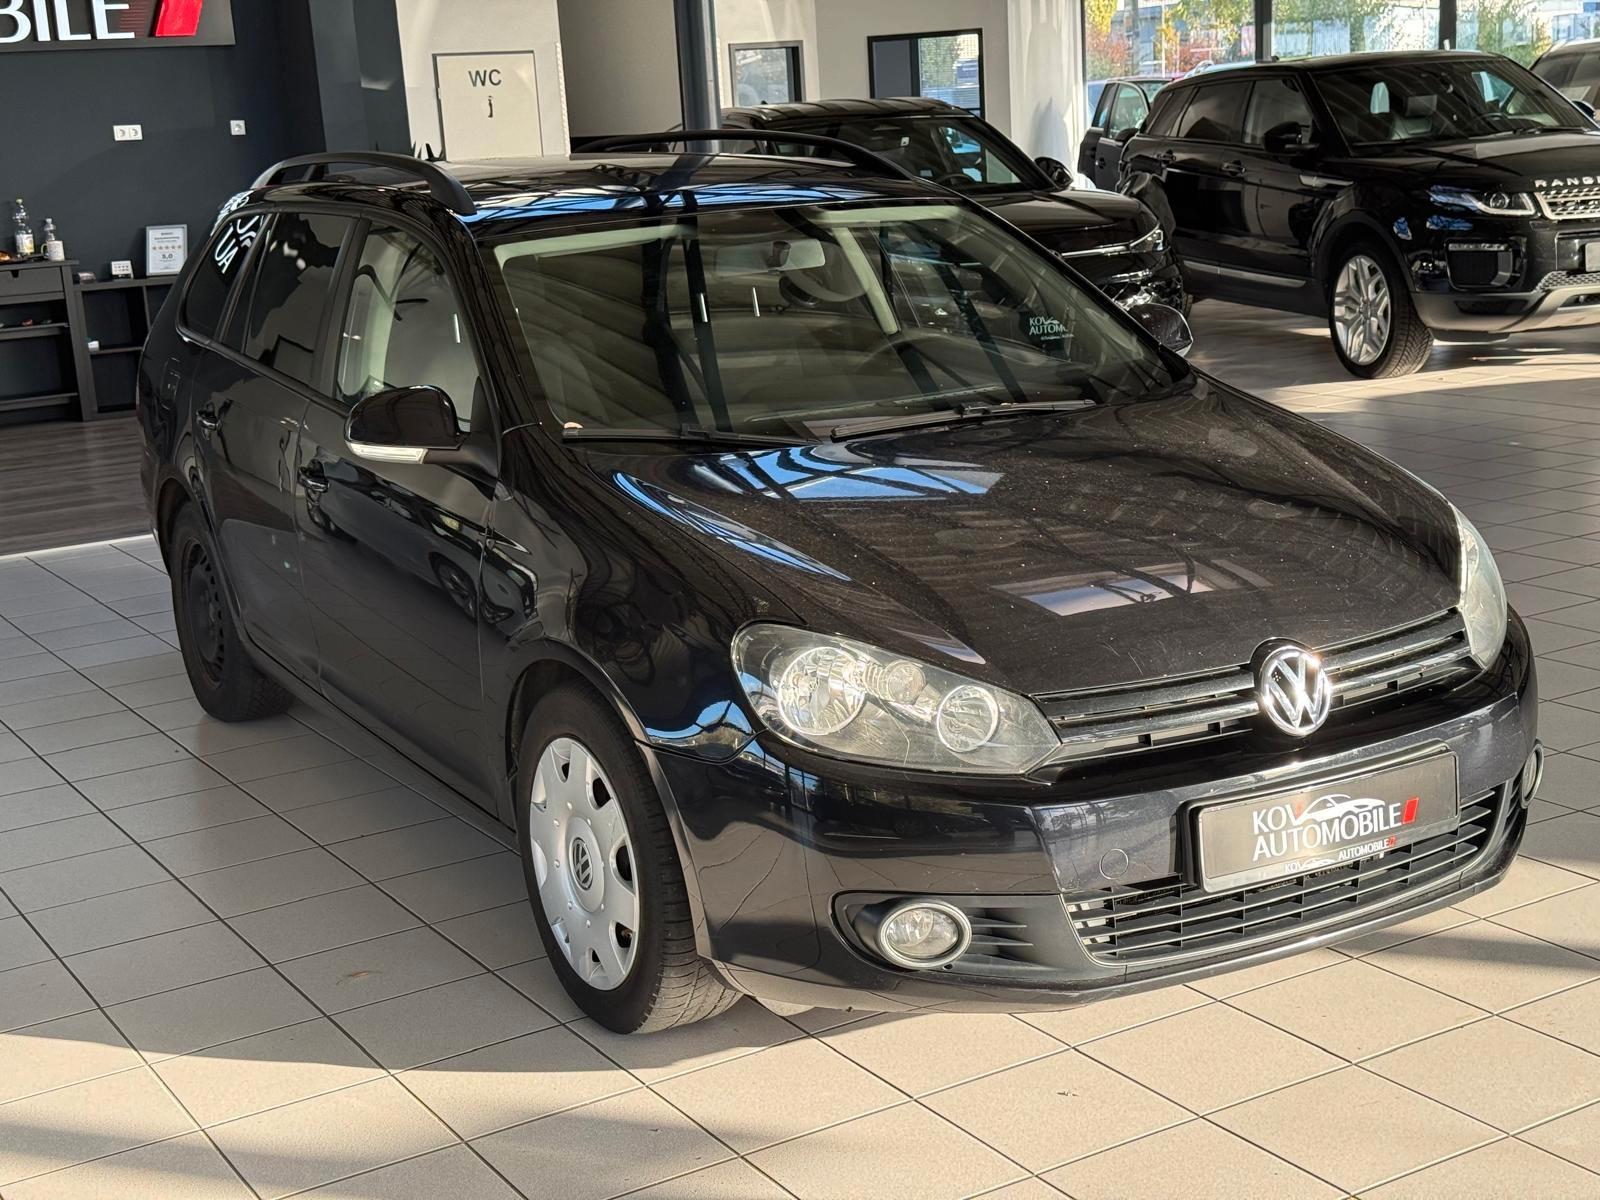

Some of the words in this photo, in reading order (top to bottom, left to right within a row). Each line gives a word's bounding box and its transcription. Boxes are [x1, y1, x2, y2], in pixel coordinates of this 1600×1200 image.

[468, 69, 502, 87] WC
[1252, 802, 1403, 862] AUTOMOBILE
[1338, 839, 1389, 860] AUTOMOBILE
